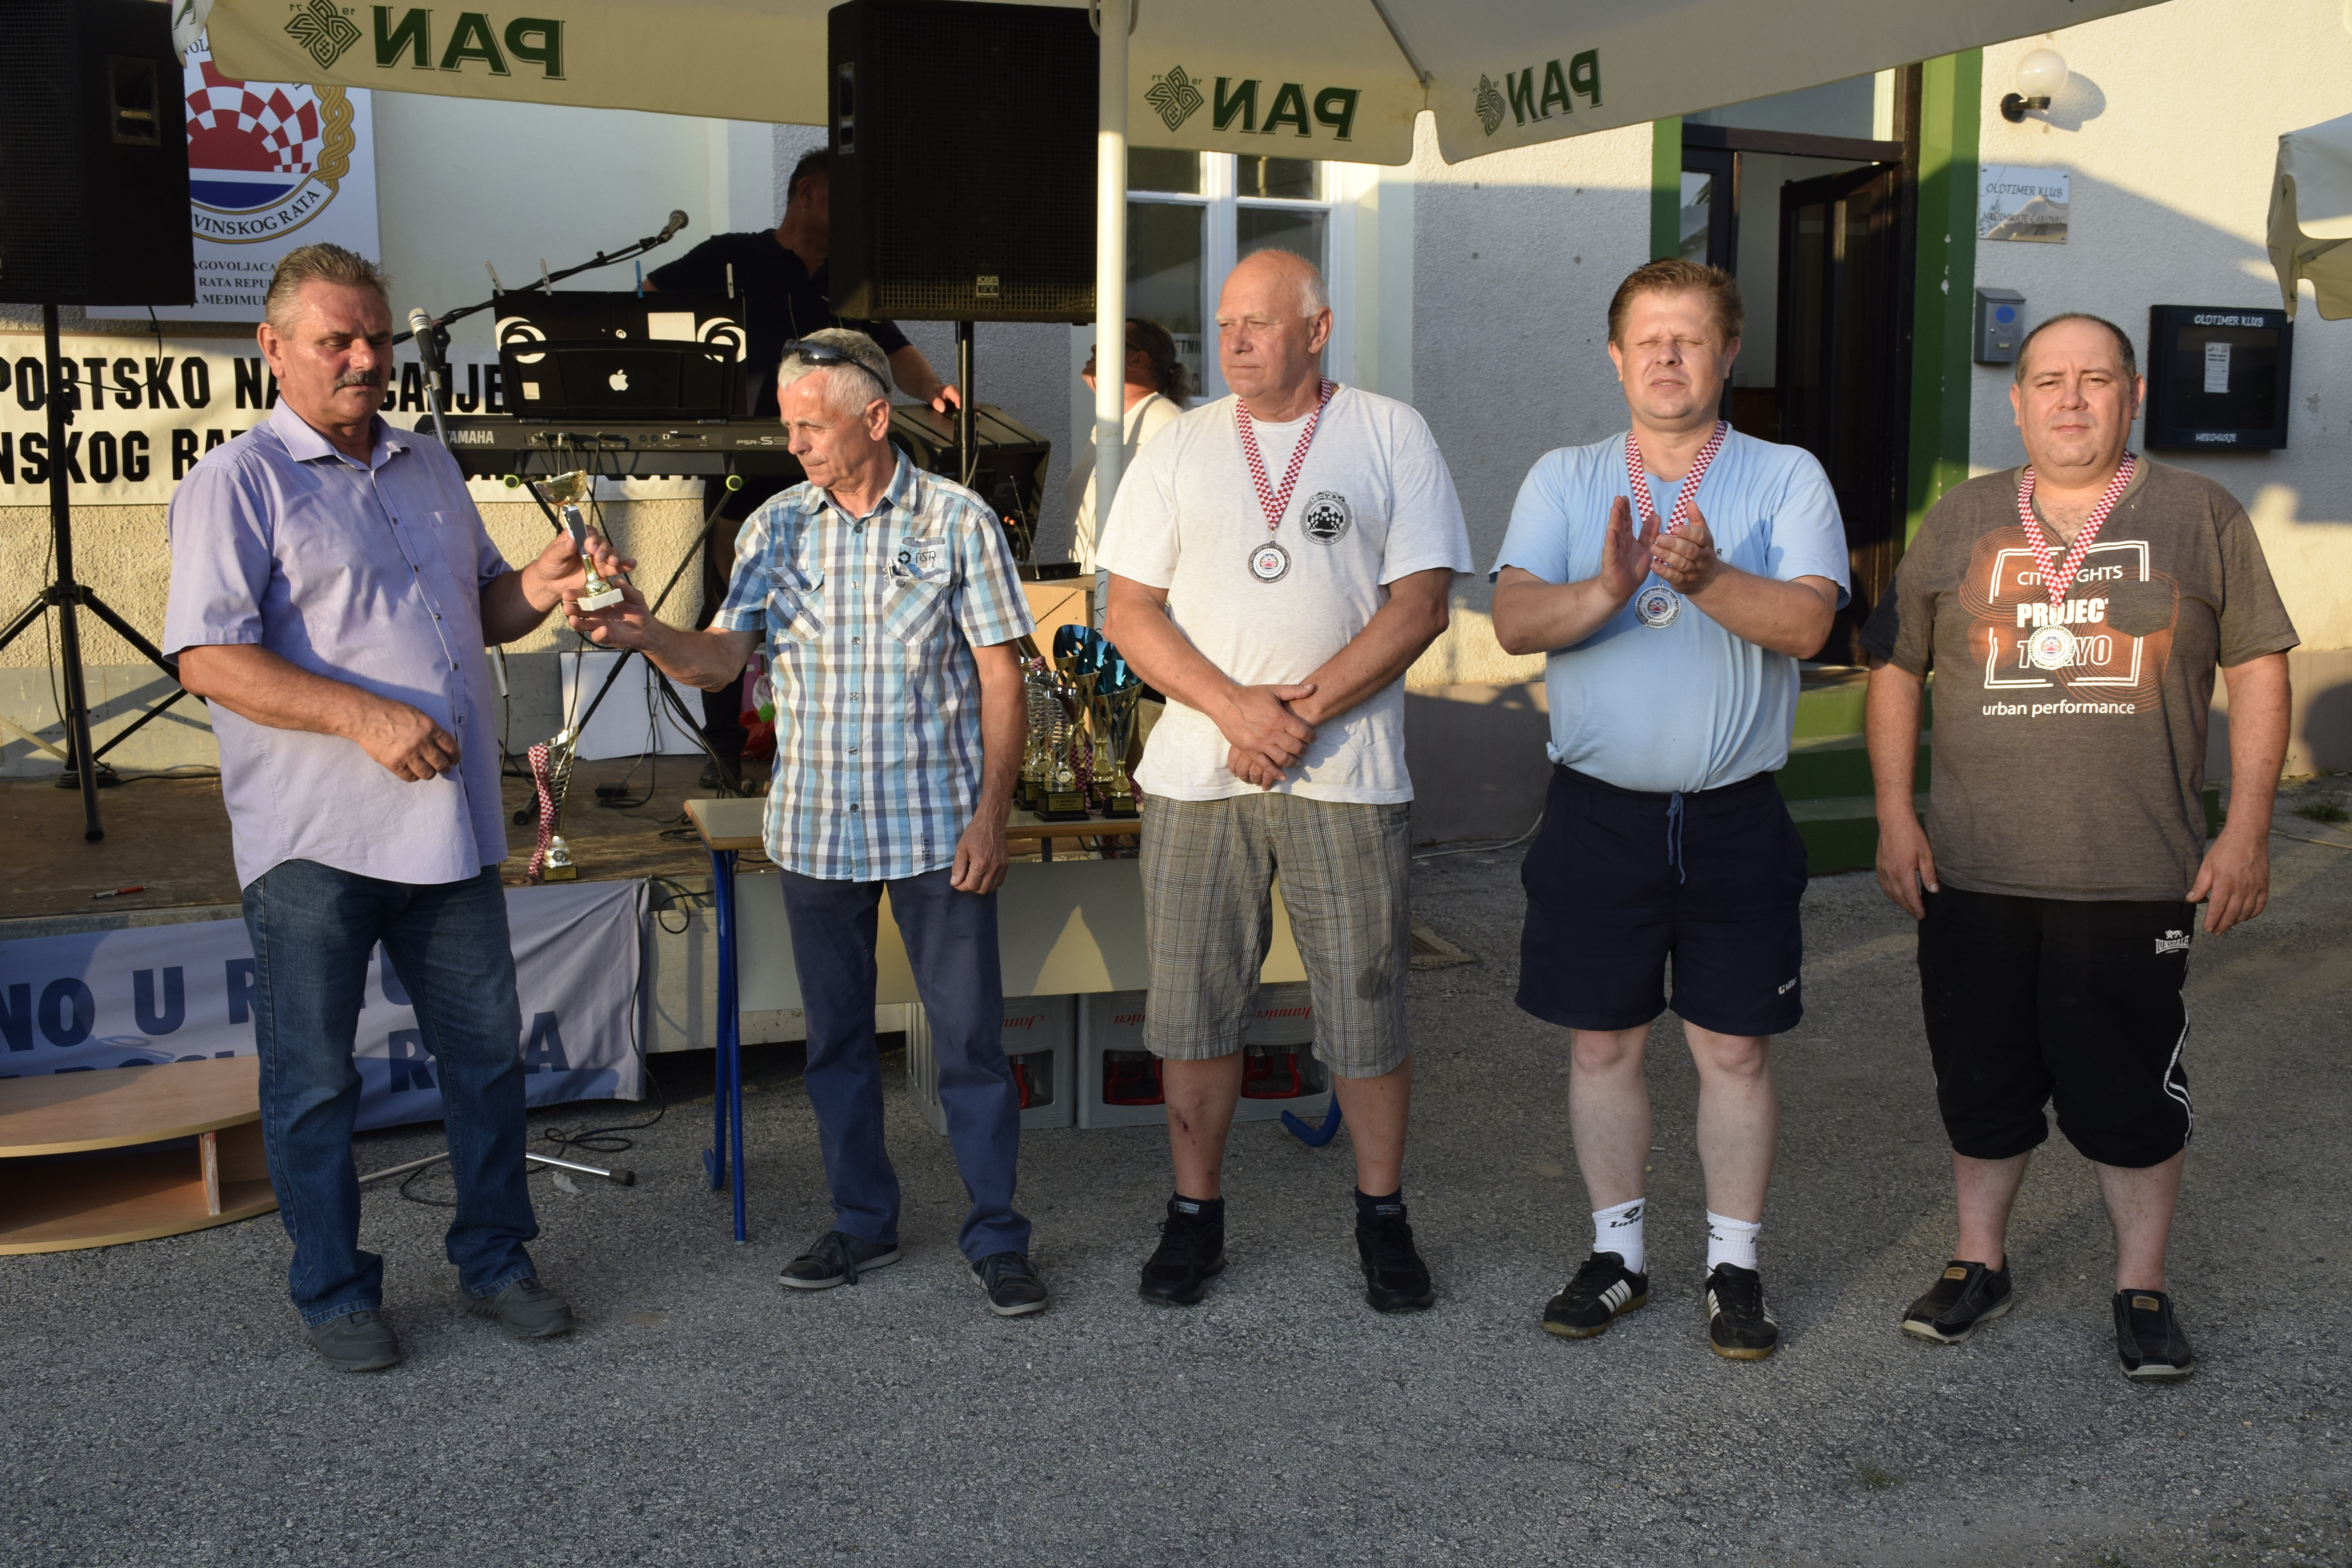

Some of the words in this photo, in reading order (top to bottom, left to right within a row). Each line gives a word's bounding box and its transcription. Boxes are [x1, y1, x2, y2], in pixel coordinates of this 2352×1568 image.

[1986, 183, 2035, 196] OLDTIMER
[2038, 187, 2063, 198] KLUB
[278, 190, 321, 225] RATA
[198, 277, 232, 287] RATA
[2194, 315, 2239, 326] OLDTIMER
[2241, 316, 2264, 327] KLUB
[448, 430, 494, 444] AMAHA
[2017, 598, 2109, 628] PROJEC
[2017, 635, 2112, 669] TYO
[1982, 702, 2027, 716] urban
[2031, 699, 2135, 718] performance
[2155, 935, 2190, 954] LONSDALE
[132, 965, 185, 1036] U
